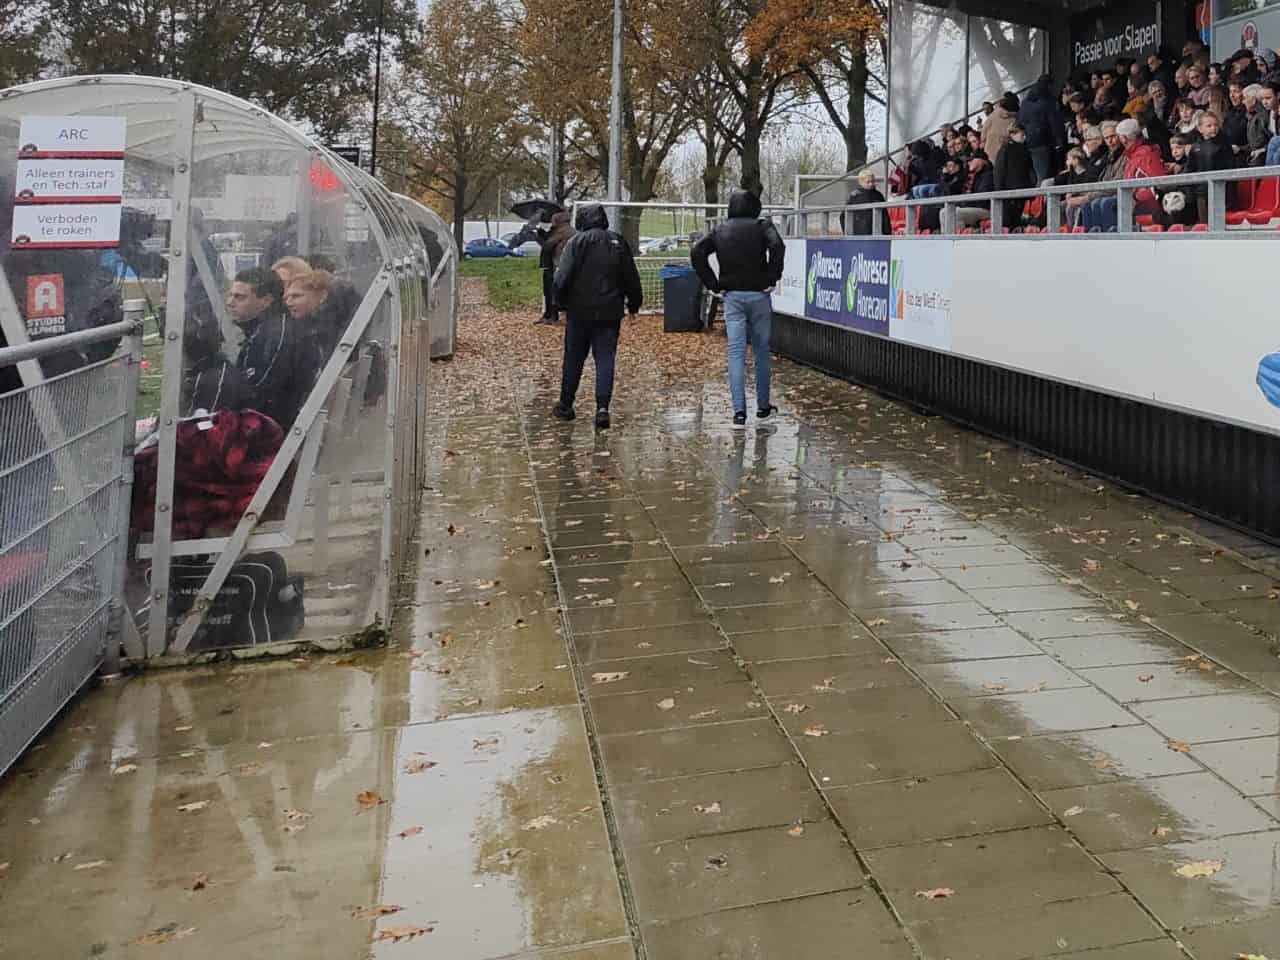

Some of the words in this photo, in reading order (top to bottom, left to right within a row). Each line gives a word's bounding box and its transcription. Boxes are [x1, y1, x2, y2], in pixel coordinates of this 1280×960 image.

[1074, 35, 1103, 65] Passie
[1103, 34, 1124, 56] voor
[1124, 23, 1158, 55] Slapen
[58, 128, 89, 140] ARC
[25, 168, 65, 178] Alleen
[68, 168, 115, 178] trainers
[32, 182, 48, 190] en
[41, 226, 54, 235] te
[57, 225, 92, 235] roken
[817, 251, 842, 280] Horesca
[857, 252, 888, 286] Horesca
[815, 283, 841, 313] Horecavo
[856, 287, 887, 322] Horecavo
